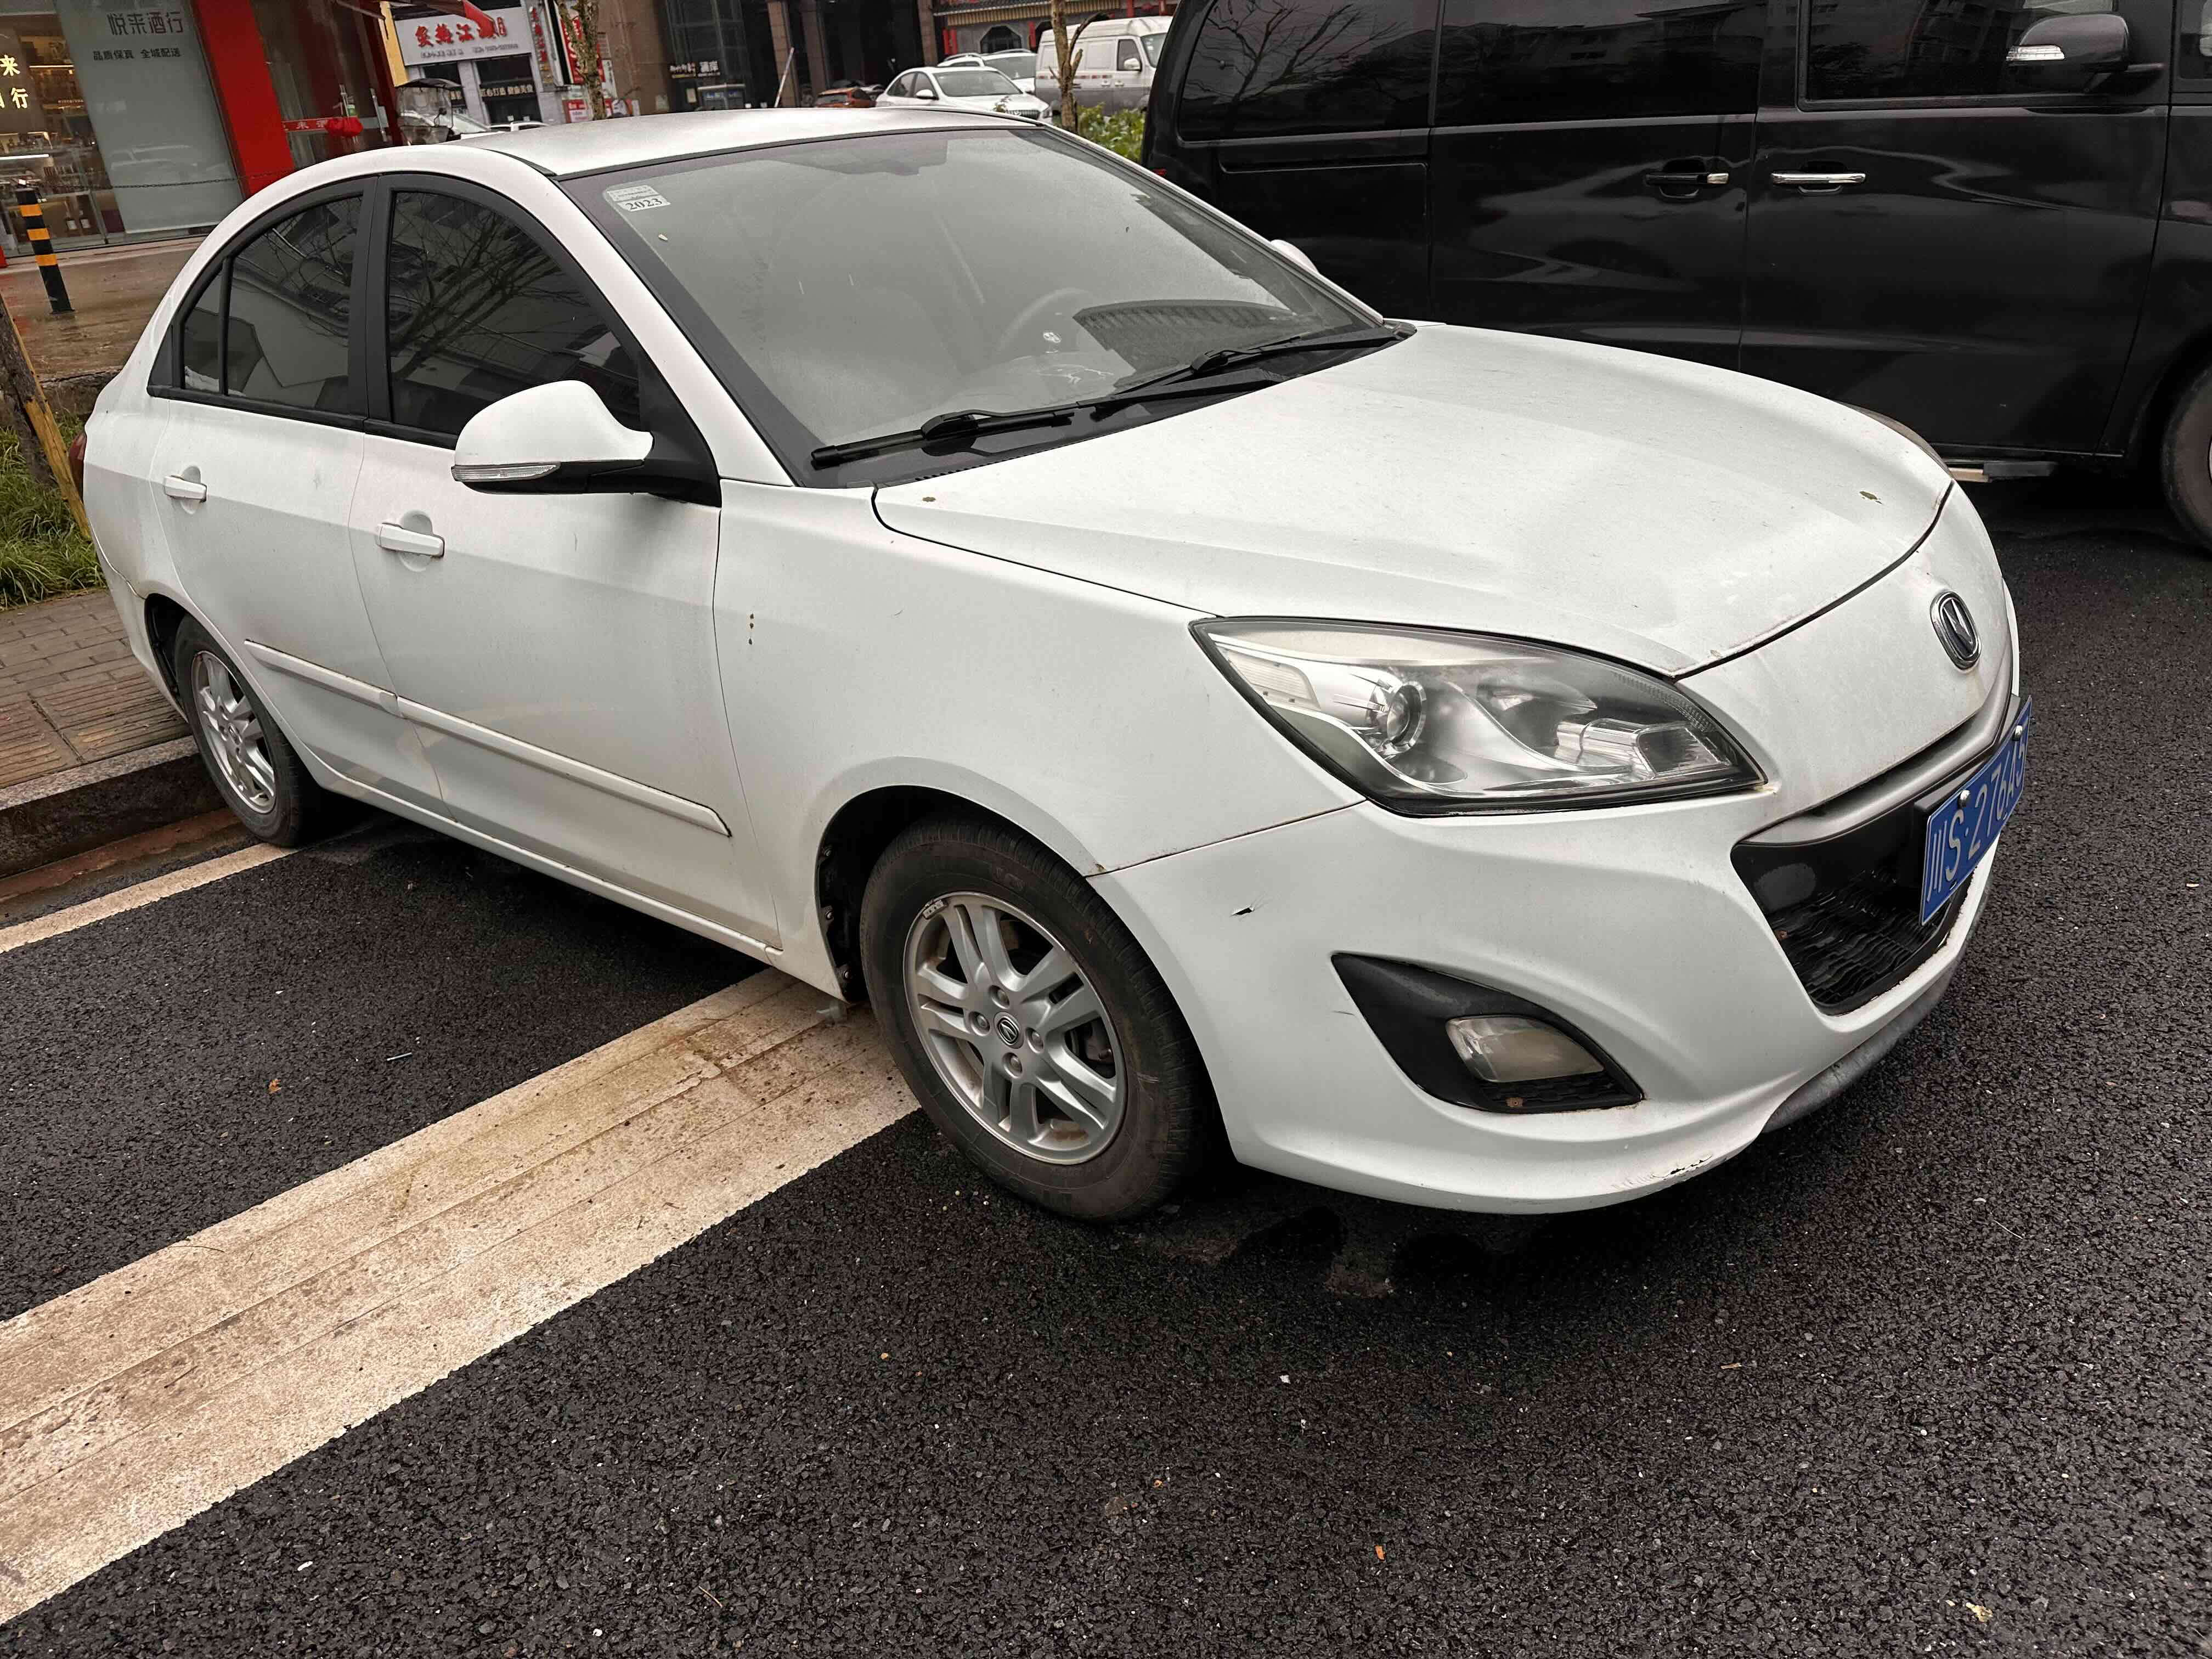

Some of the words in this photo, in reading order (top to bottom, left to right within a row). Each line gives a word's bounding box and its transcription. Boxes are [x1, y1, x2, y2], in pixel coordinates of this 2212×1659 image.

[106, 12, 183, 36] 悦来酒行
[93, 49, 135, 61] 品质保真
[140, 47, 182, 59] 全城配送
[625, 198, 663, 210] 2023
